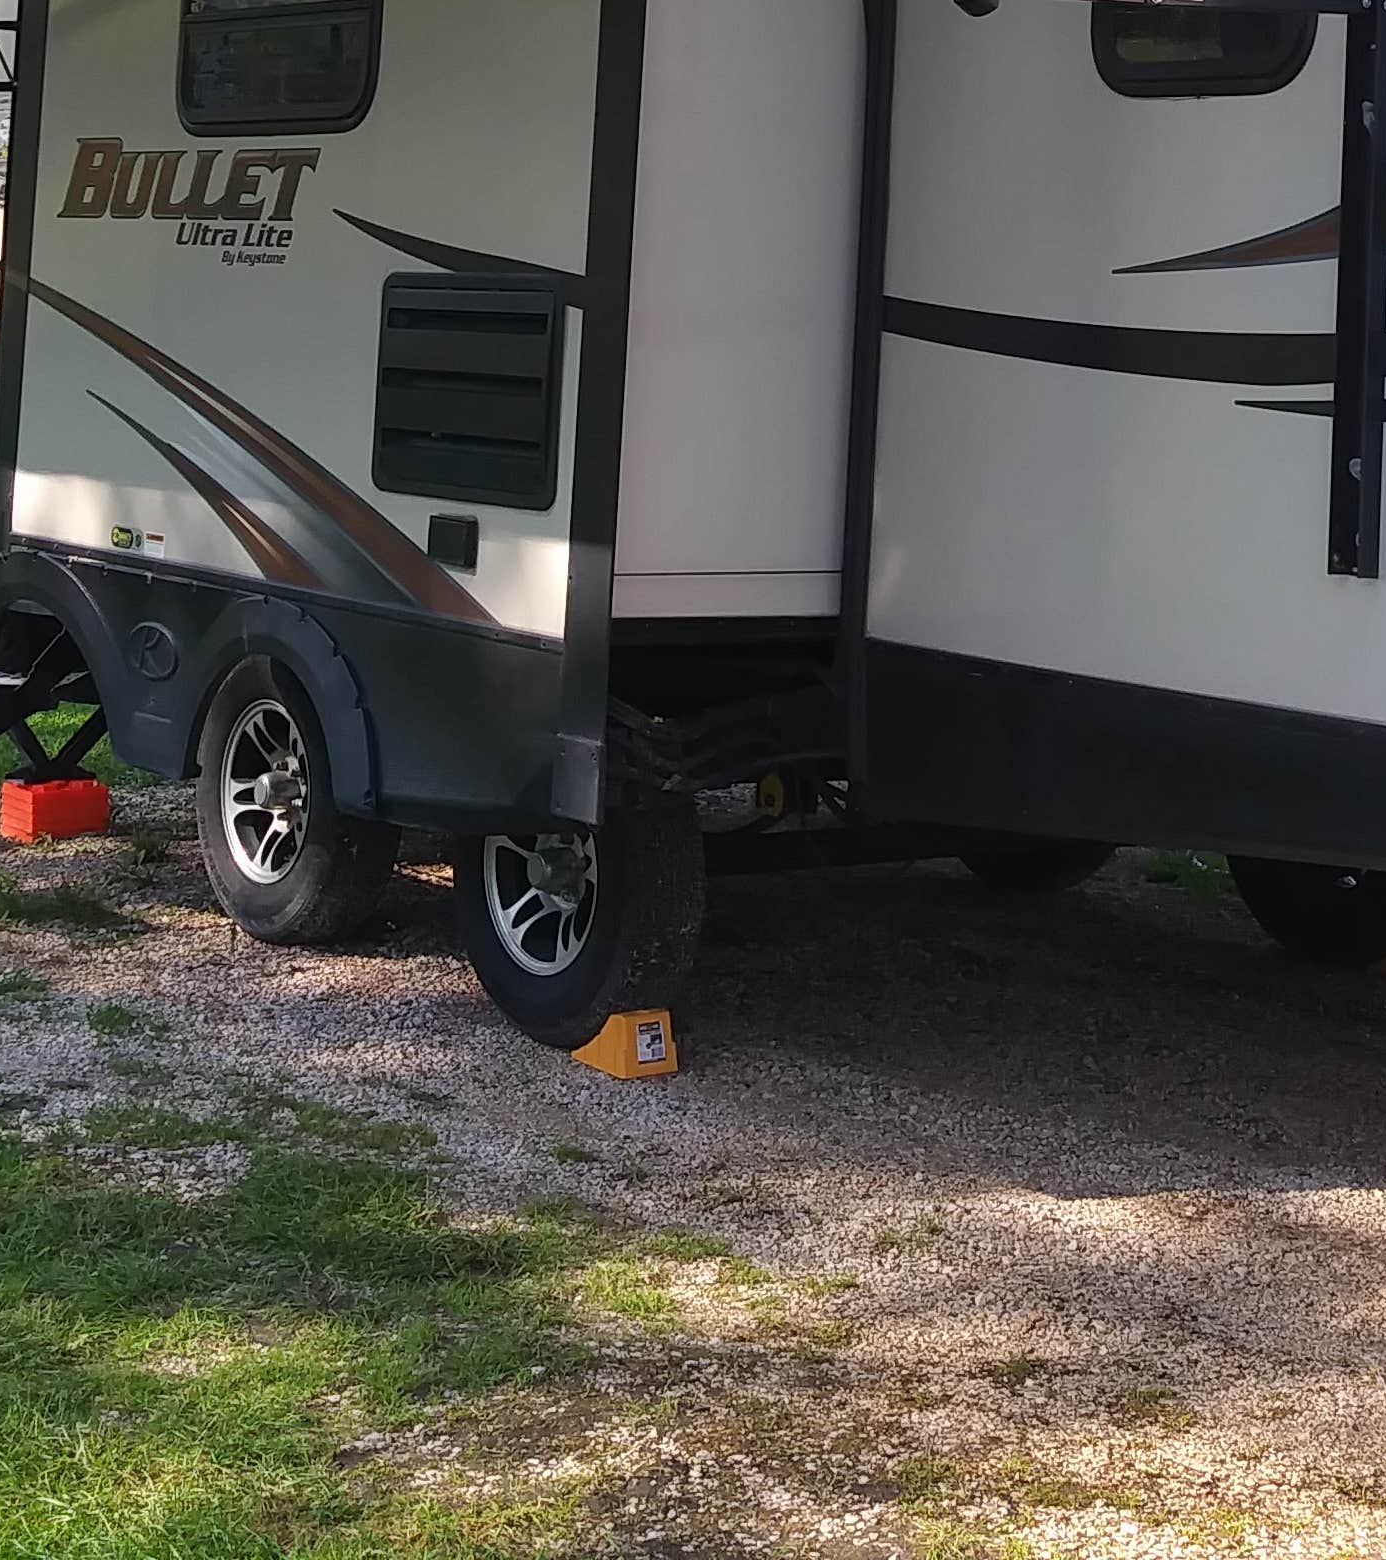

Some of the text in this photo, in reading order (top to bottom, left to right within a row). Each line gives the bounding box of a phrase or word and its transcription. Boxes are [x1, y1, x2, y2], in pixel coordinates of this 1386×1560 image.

[56, 137, 321, 221] BULLET
[175, 222, 293, 248] Ultra Lite
[221, 250, 287, 267] By Keystone
